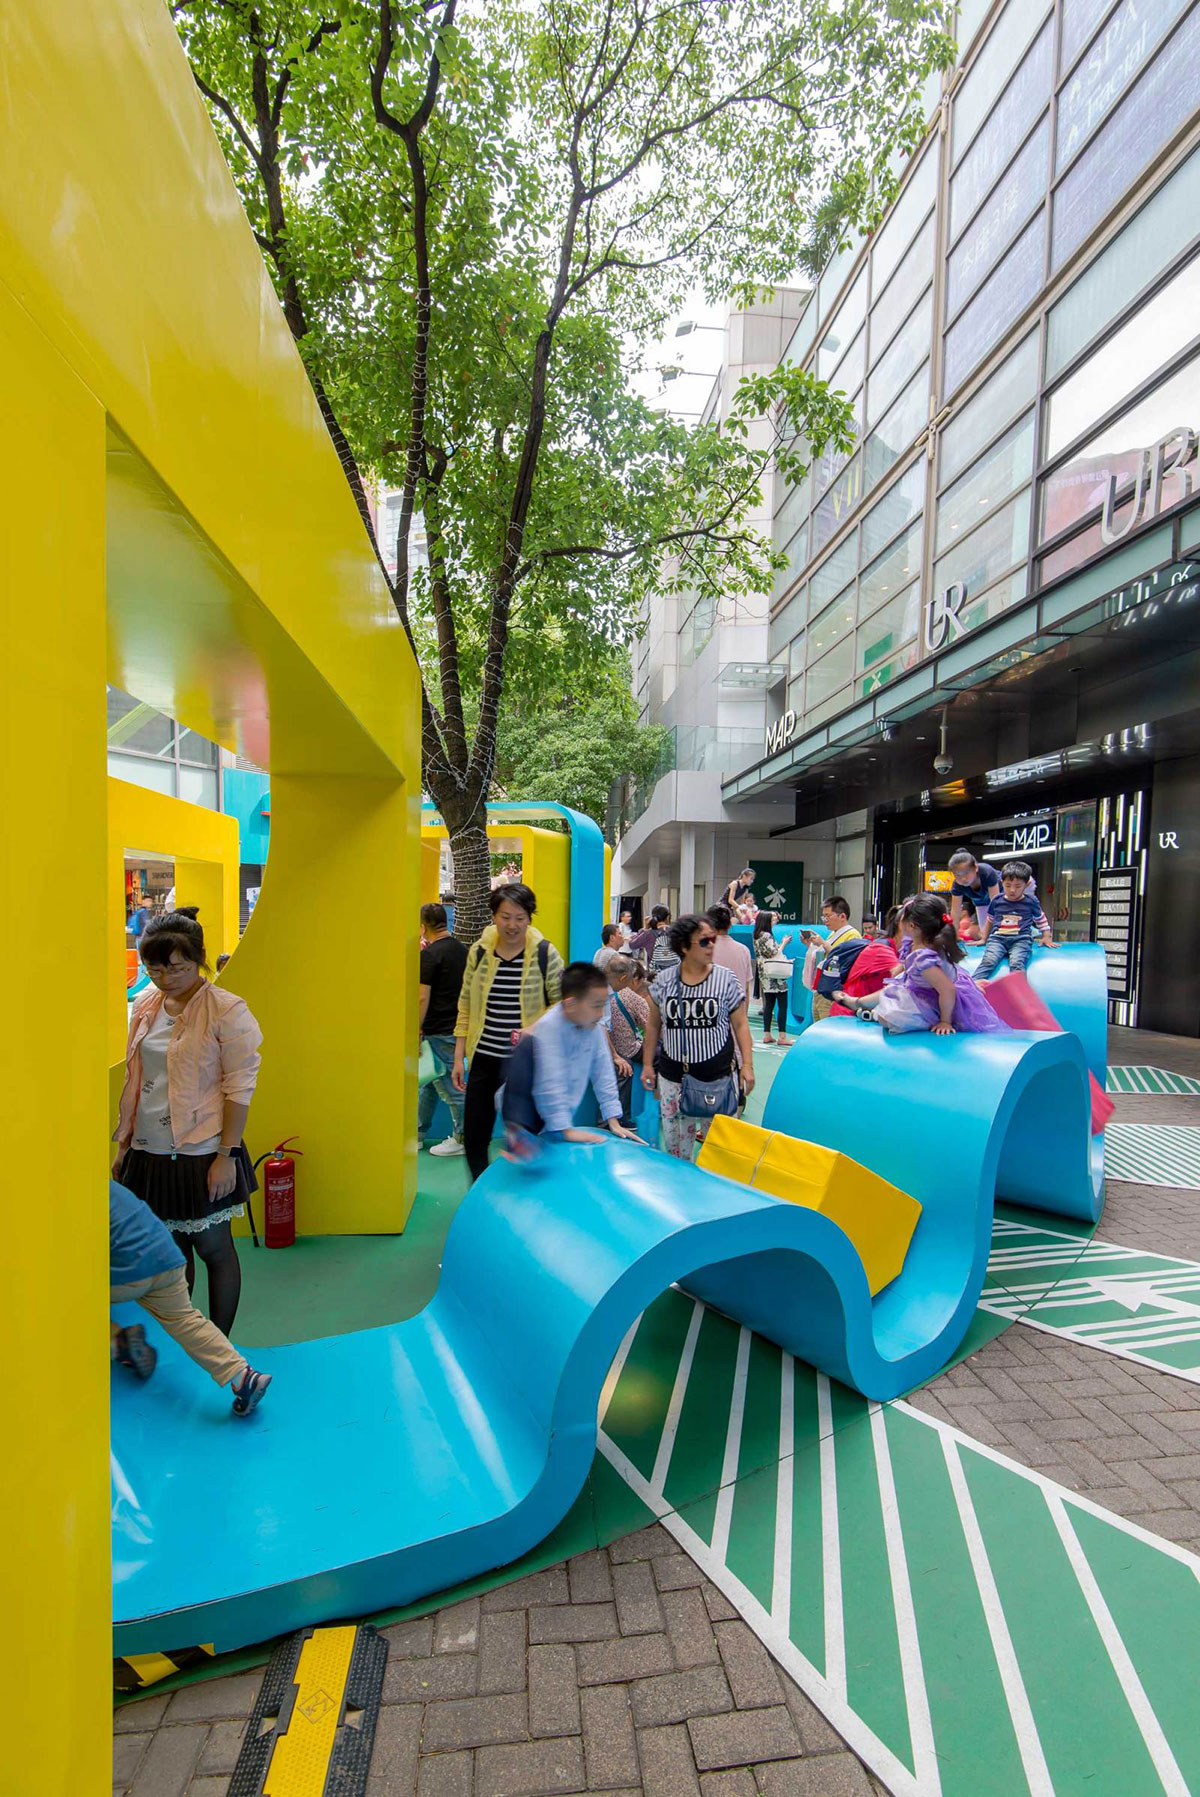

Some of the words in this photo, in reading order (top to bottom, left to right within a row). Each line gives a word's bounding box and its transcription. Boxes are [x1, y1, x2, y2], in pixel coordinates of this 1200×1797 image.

[1102, 426, 1194, 545] UR
[923, 581, 970, 651] UR
[765, 709, 797, 758] MAP
[1012, 824, 1050, 851] MAP
[1158, 831, 1179, 849] UR
[666, 998, 719, 1020] COCO
[673, 1019, 713, 1027] NGHTS
